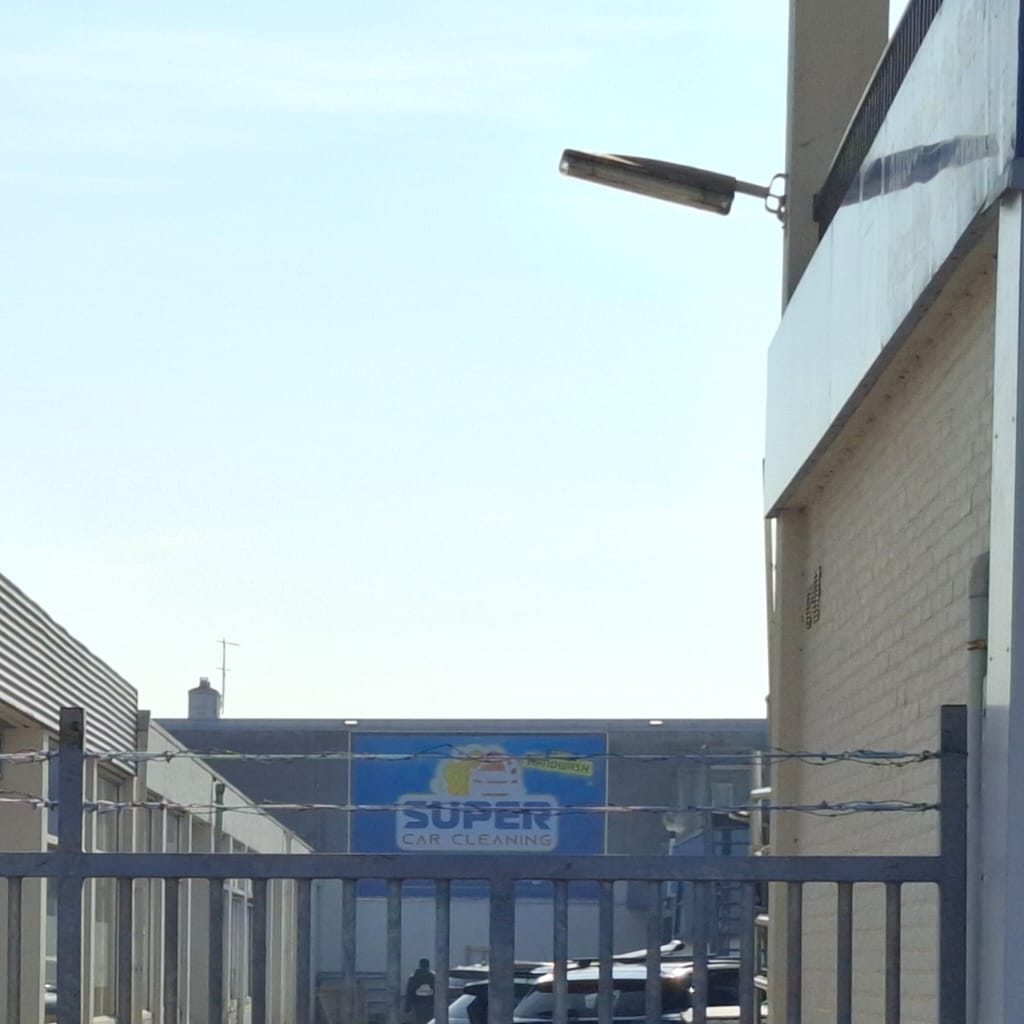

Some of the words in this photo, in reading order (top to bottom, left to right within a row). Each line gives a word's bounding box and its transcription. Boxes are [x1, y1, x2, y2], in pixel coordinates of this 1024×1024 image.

[402, 800, 552, 830] SUPER
[401, 833, 441, 846] CAR
[451, 833, 553, 847] CLEANING
